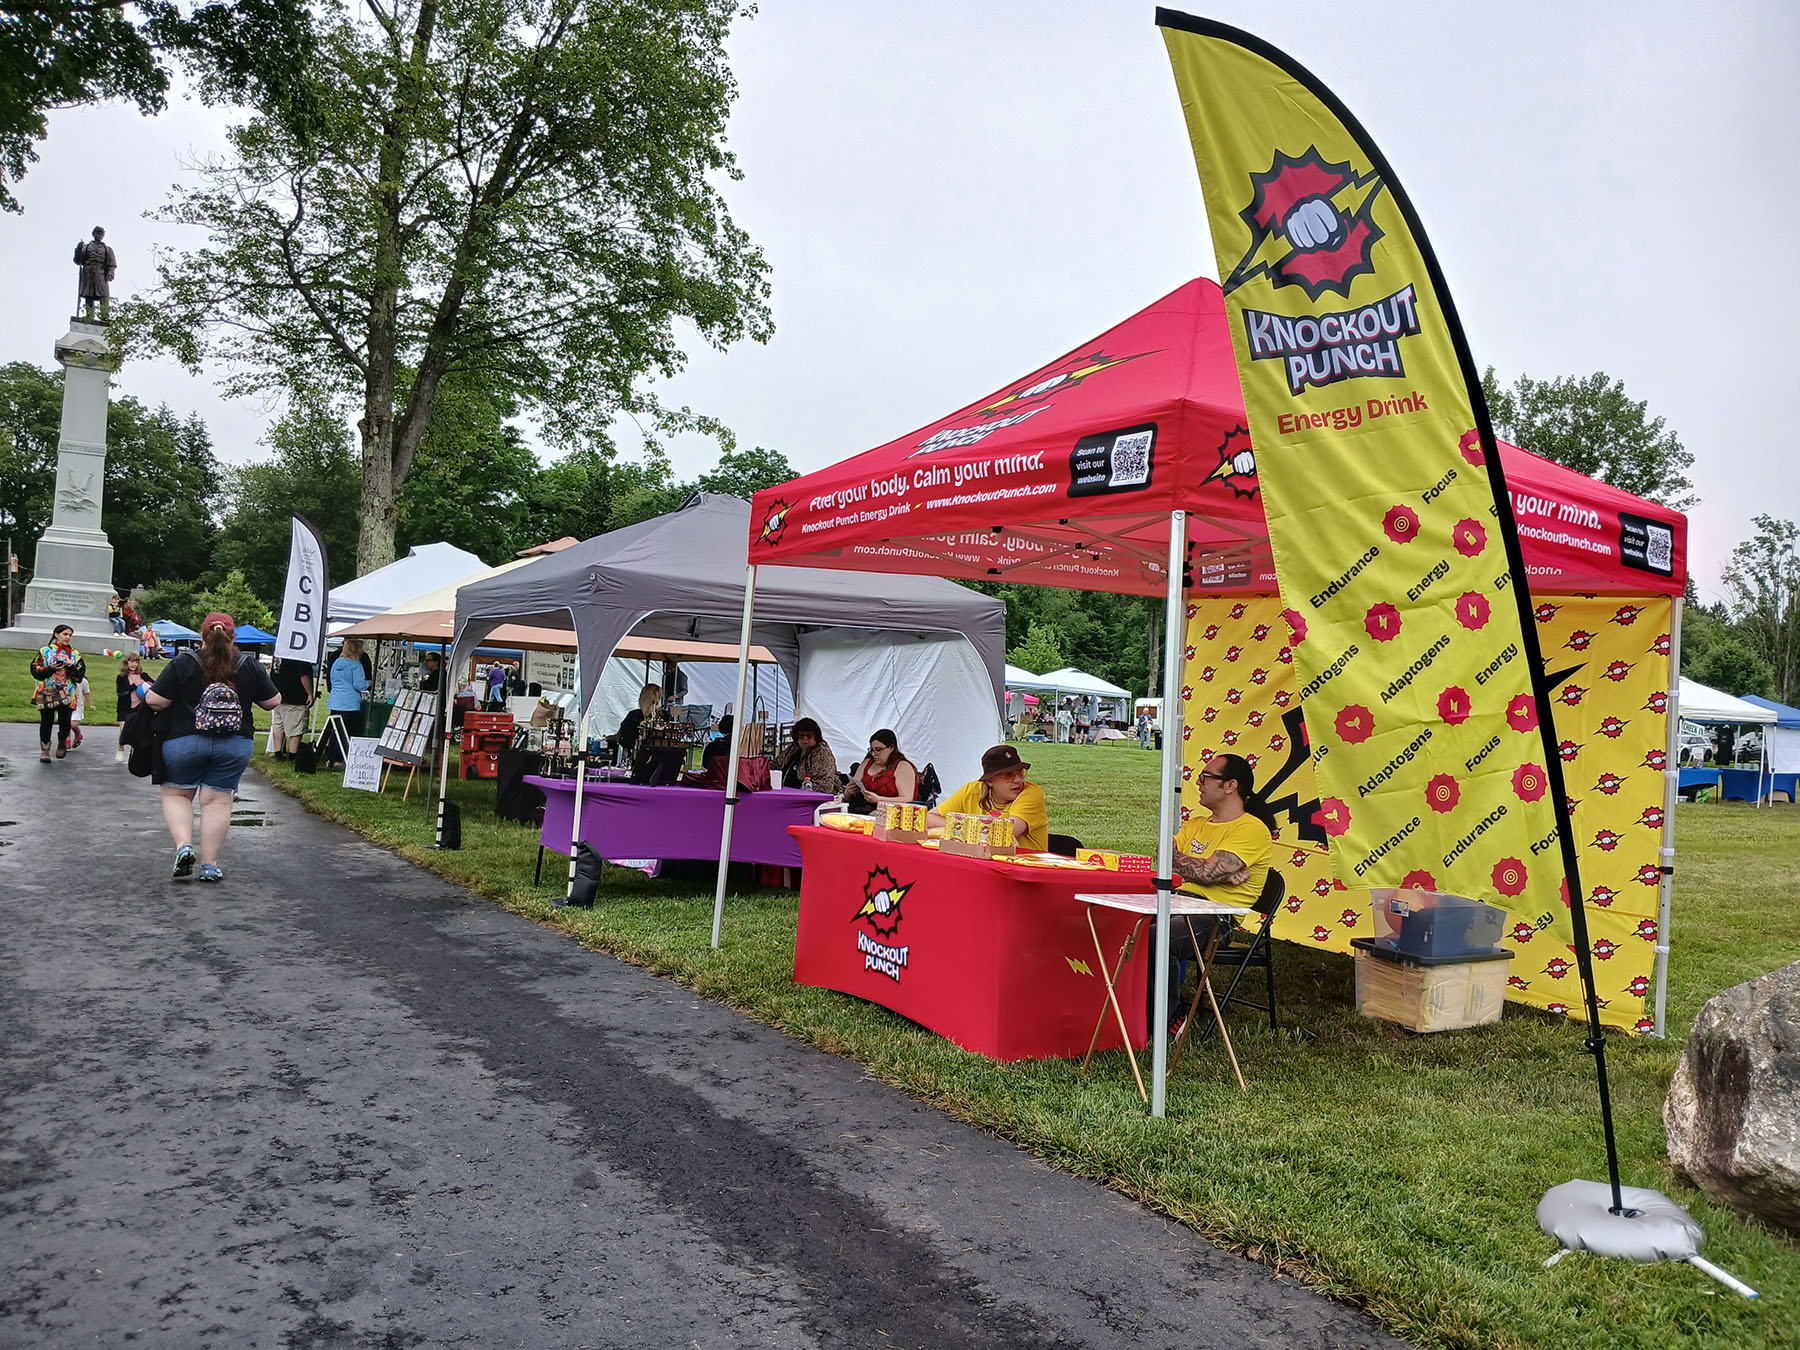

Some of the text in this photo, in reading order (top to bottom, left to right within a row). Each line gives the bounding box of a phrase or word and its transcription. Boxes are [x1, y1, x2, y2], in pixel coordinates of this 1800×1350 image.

[1247, 286, 1416, 355] KNOCKOUT
[1288, 340, 1400, 390] PUNCH
[1277, 391, 1429, 435] Energy Drink
[1076, 446, 1105, 457] Scan to
[1076, 460, 1105, 470] visit our
[838, 484, 869, 509] your
[871, 473, 910, 496] body.
[913, 465, 951, 488] Calm
[954, 459, 991, 487] your
[1077, 473, 1106, 484] website
[1421, 468, 1458, 504] Focus
[801, 483, 1057, 534] Knockout Punch Energy Drink www.KnockoutPunch.com
[1516, 493, 1557, 515] your
[1557, 503, 1602, 530] mind.
[1309, 545, 1380, 609] Endurance
[1406, 558, 1450, 602] Energy
[1298, 644, 1360, 703] aptogens
[1379, 633, 1451, 704] Adaptogens
[1474, 642, 1519, 686] Energy
[1357, 727, 1433, 798] Adaptogens
[1464, 734, 1502, 772] Focus
[1353, 814, 1421, 877] Endurance
[1442, 803, 1508, 868] Endurance
[1529, 825, 1560, 856] Focu
[857, 929, 909, 967] KNOCKOUT
[865, 954, 899, 982] PUNCH
